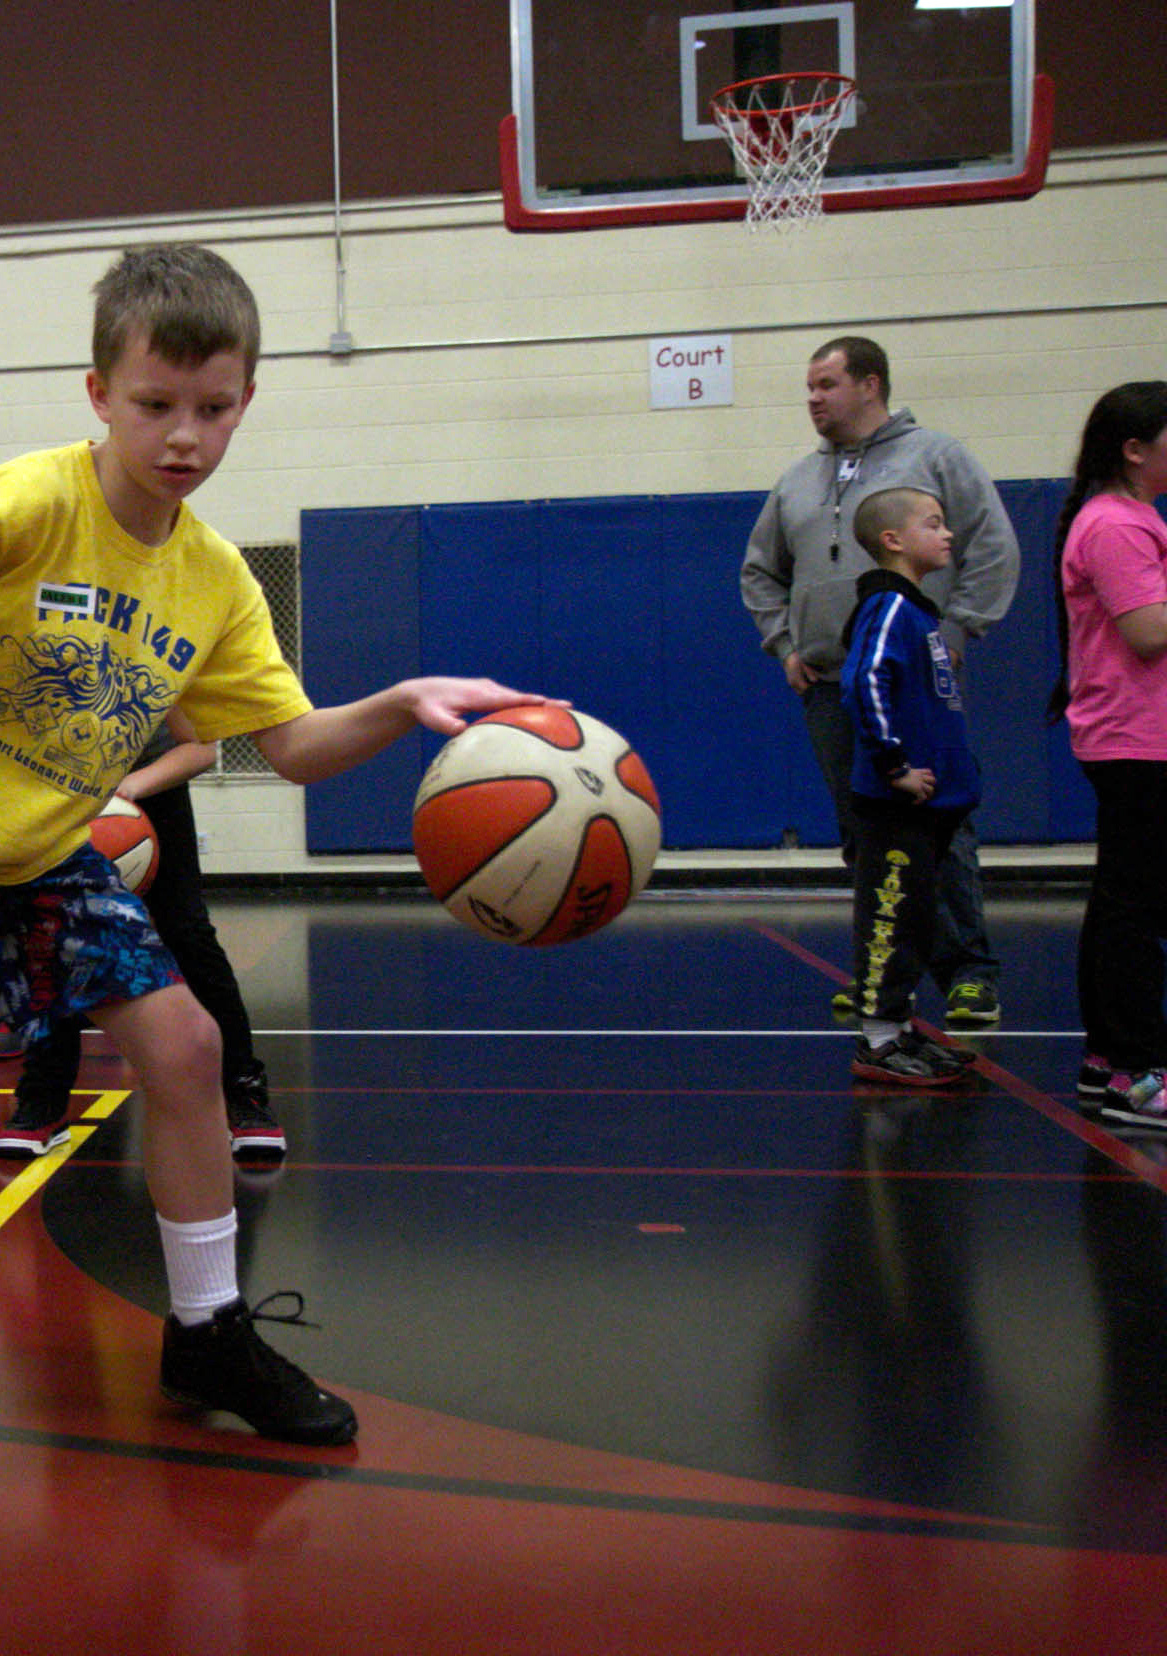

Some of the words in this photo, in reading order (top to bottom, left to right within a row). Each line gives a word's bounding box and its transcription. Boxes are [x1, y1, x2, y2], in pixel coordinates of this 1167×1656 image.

[656, 345, 725, 368] Court
[688, 377, 704, 401] B
[38, 583, 141, 634] CK
[14, 747, 67, 786] Leonard
